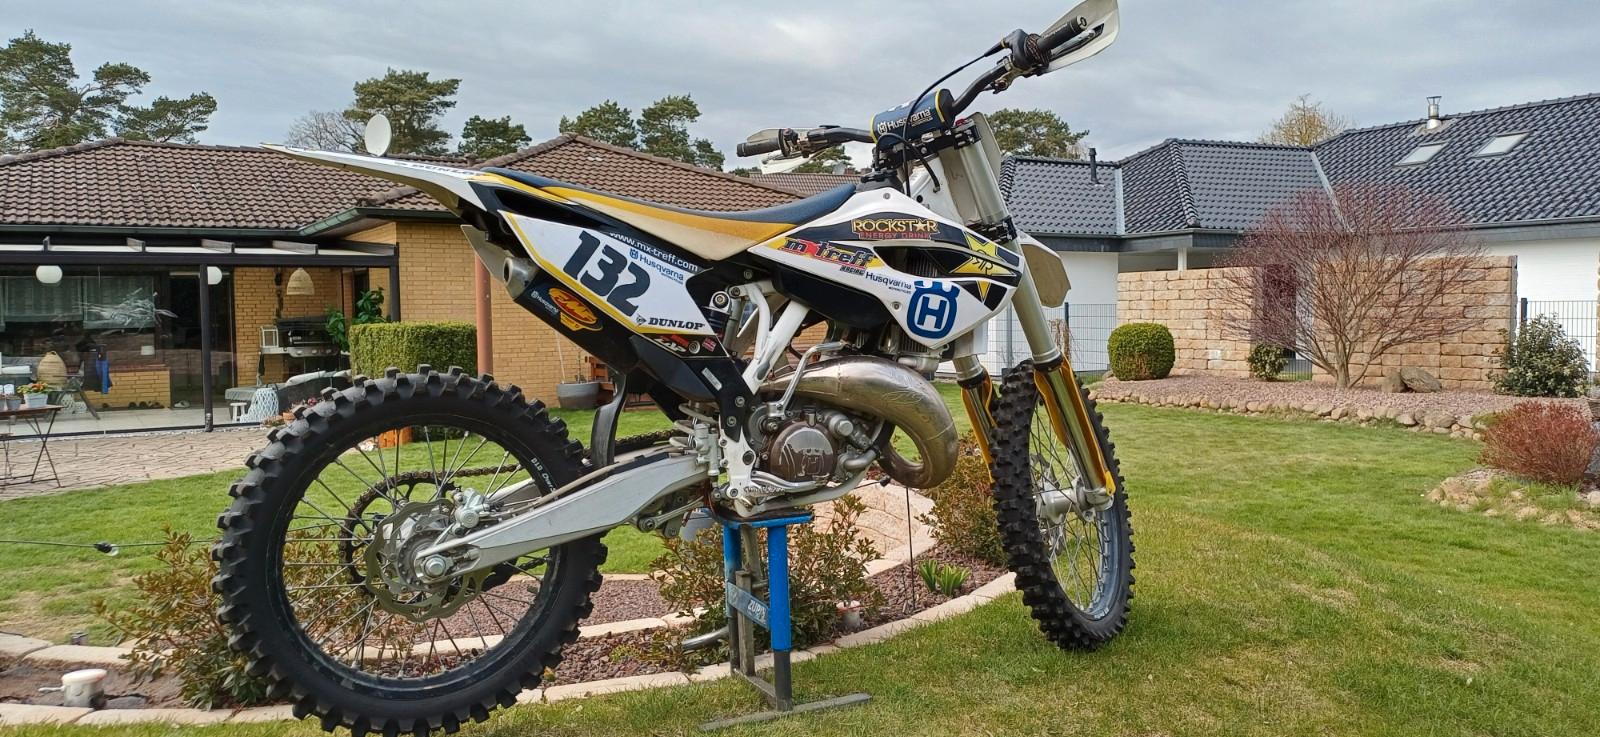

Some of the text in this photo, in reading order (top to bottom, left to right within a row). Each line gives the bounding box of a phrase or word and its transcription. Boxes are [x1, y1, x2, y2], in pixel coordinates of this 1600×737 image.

[563, 230, 651, 317] 132
[639, 254, 684, 281] Husqvarna
[864, 271, 912, 290] Husqvarna
[648, 317, 704, 330] DUNLOP
